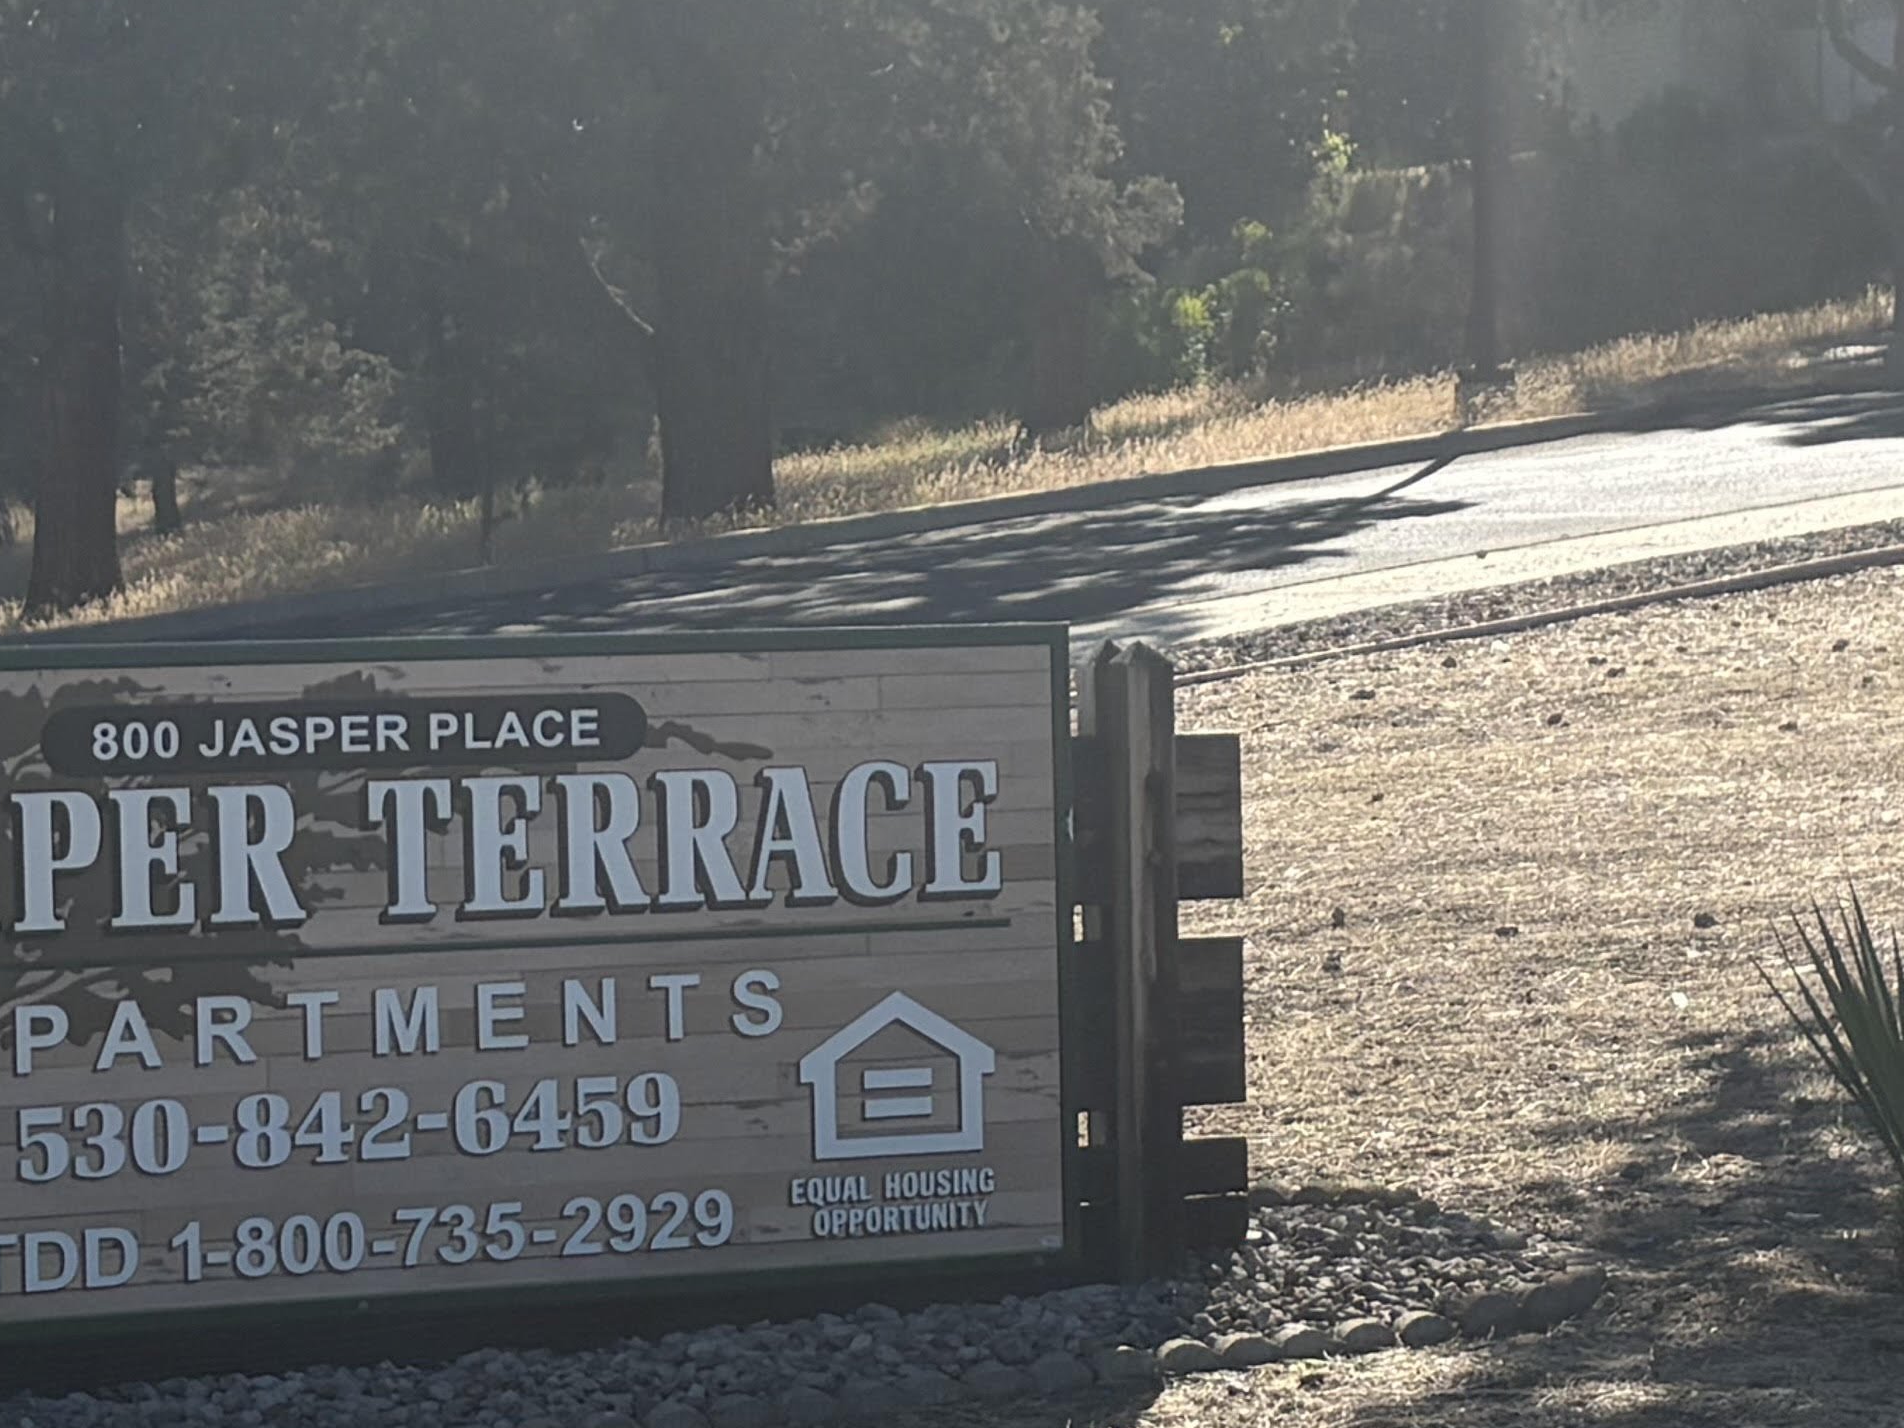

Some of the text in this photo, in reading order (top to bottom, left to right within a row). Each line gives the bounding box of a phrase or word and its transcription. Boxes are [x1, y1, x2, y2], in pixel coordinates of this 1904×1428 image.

[92, 707, 602, 762] 800 JASPER PLACE
[365, 758, 1003, 918] TERRACE
[15, 1071, 683, 1184] 530-842-6459
[790, 1166, 995, 1207] EQUAL HOUSING
[812, 1199, 989, 1238] OPPORTUNITY
[169, 1188, 736, 1283] 1-800-735-2929
